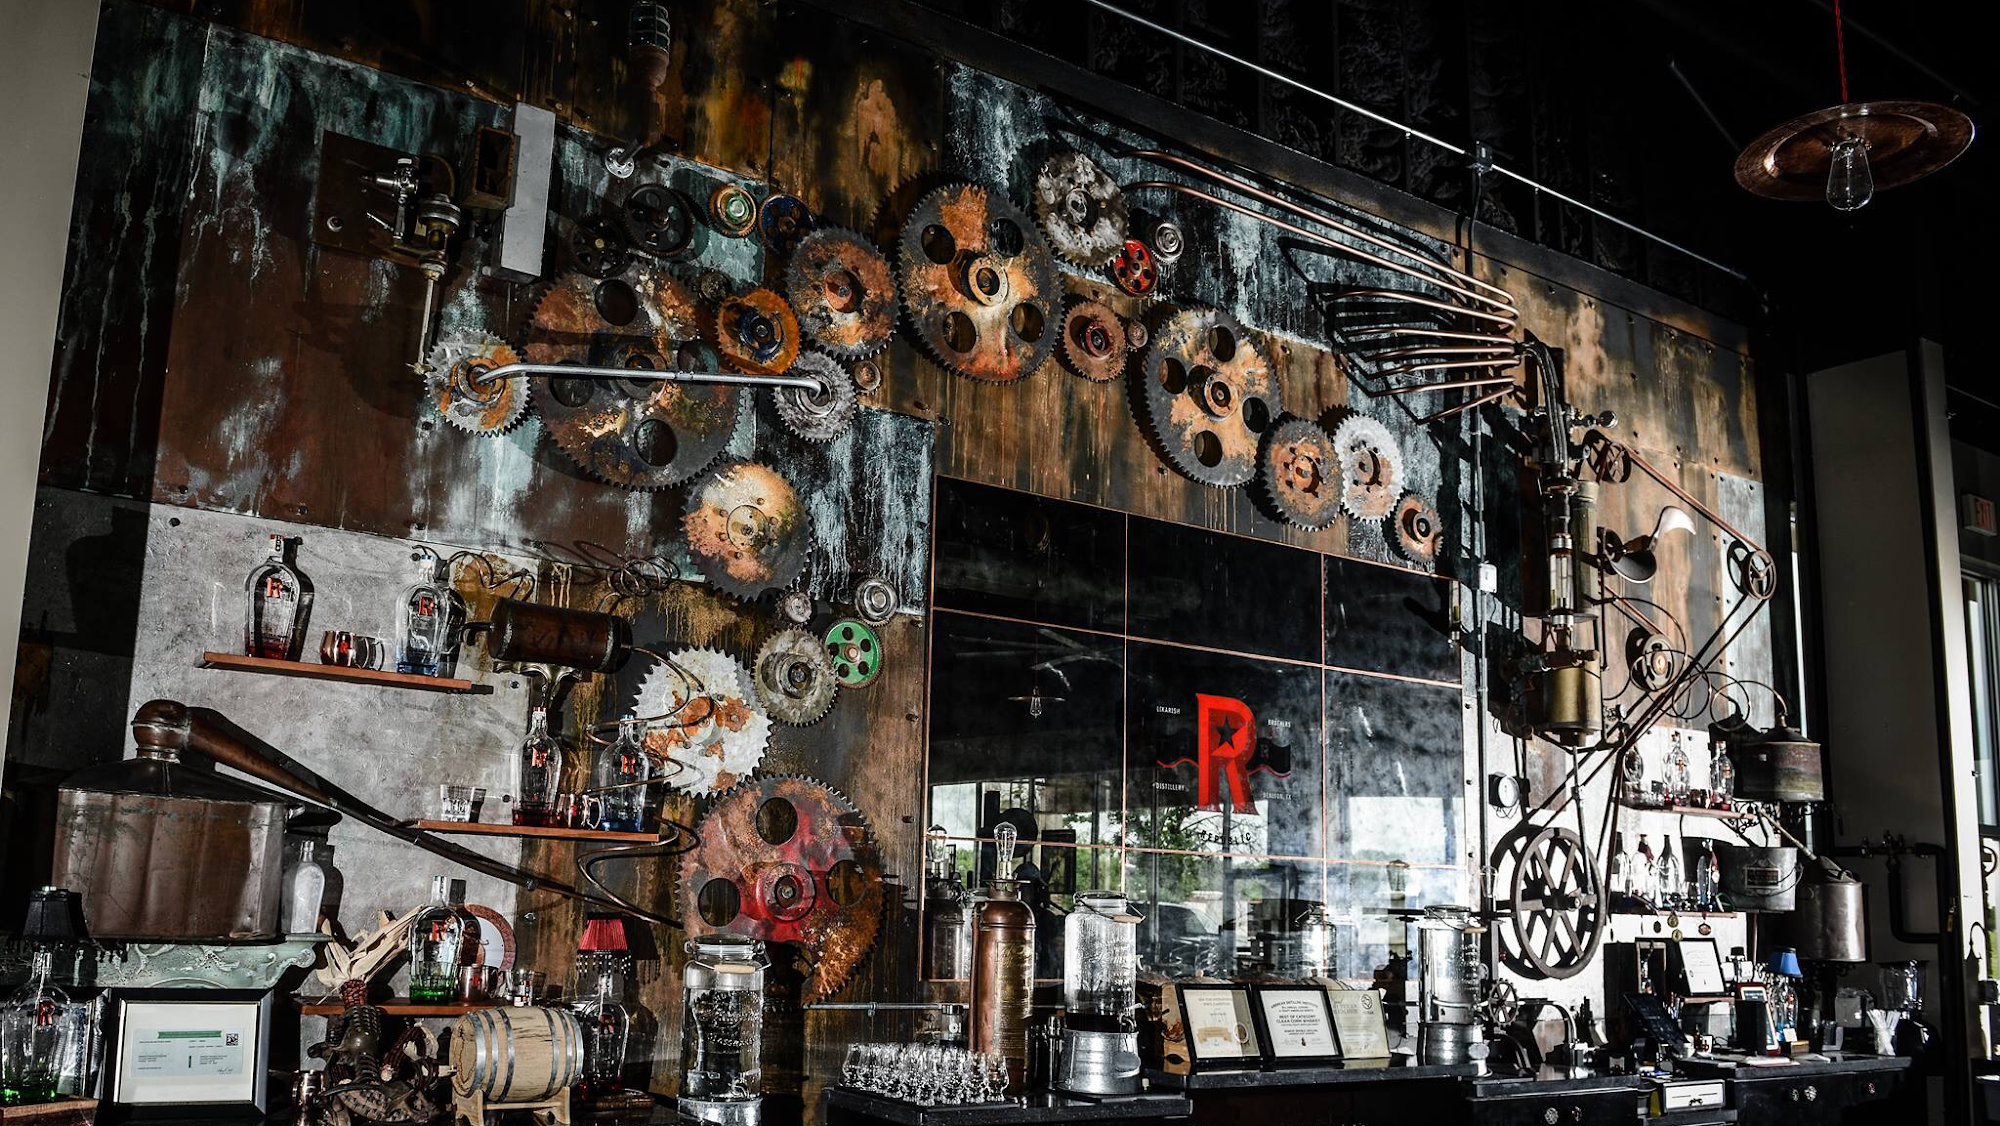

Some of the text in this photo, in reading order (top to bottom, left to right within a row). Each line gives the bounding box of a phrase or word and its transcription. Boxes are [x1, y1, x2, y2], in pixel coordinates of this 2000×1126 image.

[1195, 693, 1260, 815] R
[1155, 782, 1185, 792] DISTILLERY
[1200, 829, 1252, 845] REPUBLIC
